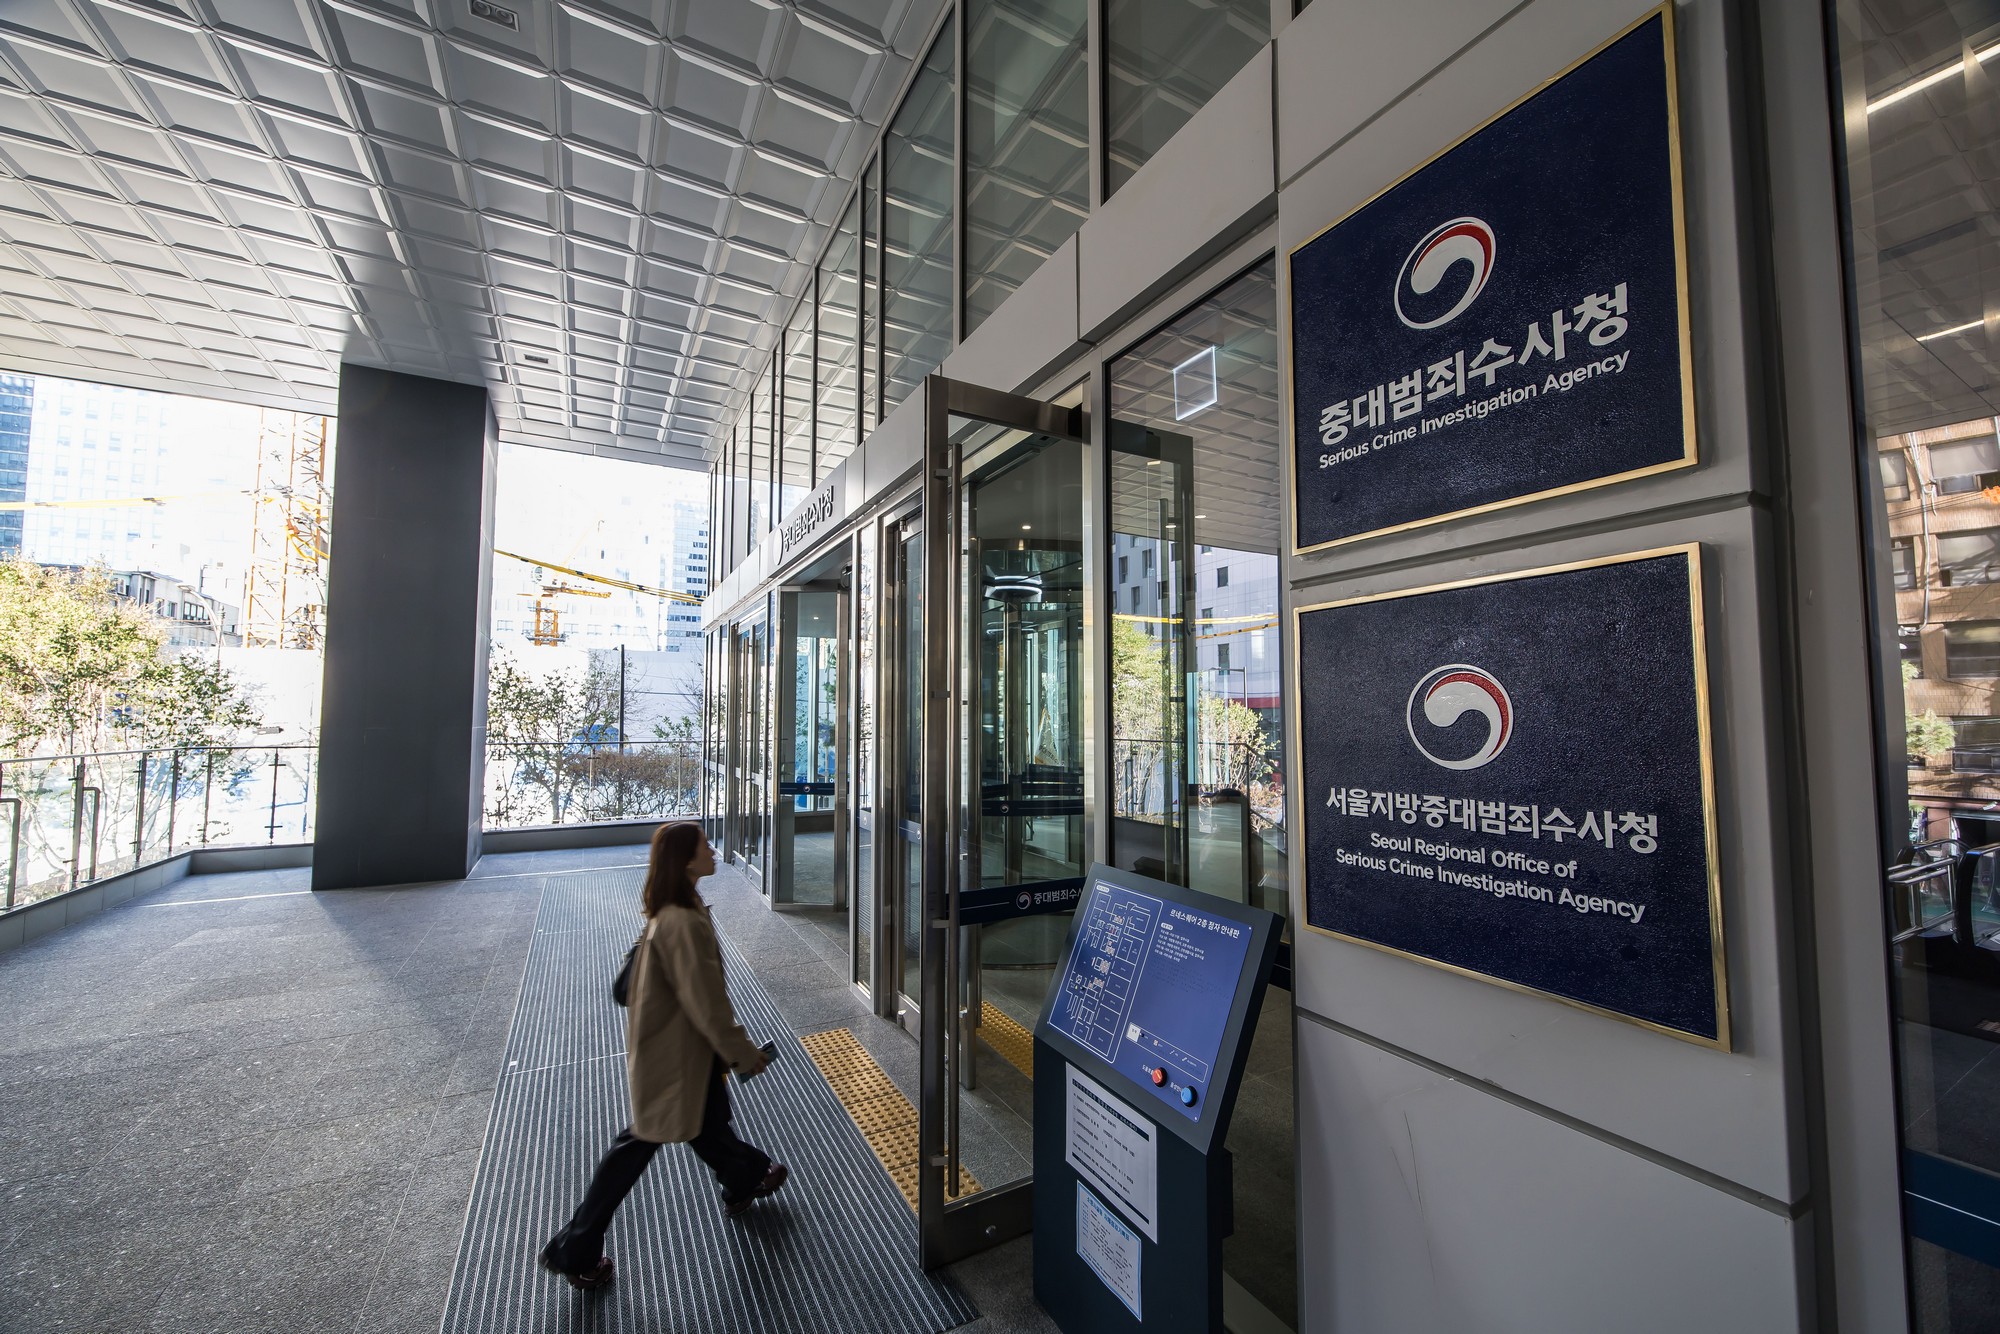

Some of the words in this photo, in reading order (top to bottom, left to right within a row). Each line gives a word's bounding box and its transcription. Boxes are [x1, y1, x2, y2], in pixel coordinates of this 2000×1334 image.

[1318, 282, 1629, 446] 중대범죄수사청
[1319, 440, 1369, 469] Serious
[1372, 423, 1417, 452] Crime
[1421, 383, 1538, 435] Investigation
[1543, 350, 1631, 393] Agency
[1326, 787, 1659, 854] 서울지방중대범죄수사청
[1371, 832, 1412, 852] Seoul
[1415, 838, 1486, 864] Regional
[1491, 850, 1550, 875] Office
[1553, 859, 1578, 879] of
[1336, 848, 1387, 872] Serious
[1389, 858, 1434, 881] Crime
[1438, 865, 1553, 903] Investigation
[1558, 887, 1646, 924] Agency
[1198, 918, 1208, 928] 2층
[1220, 925, 1240, 939] 안내판
